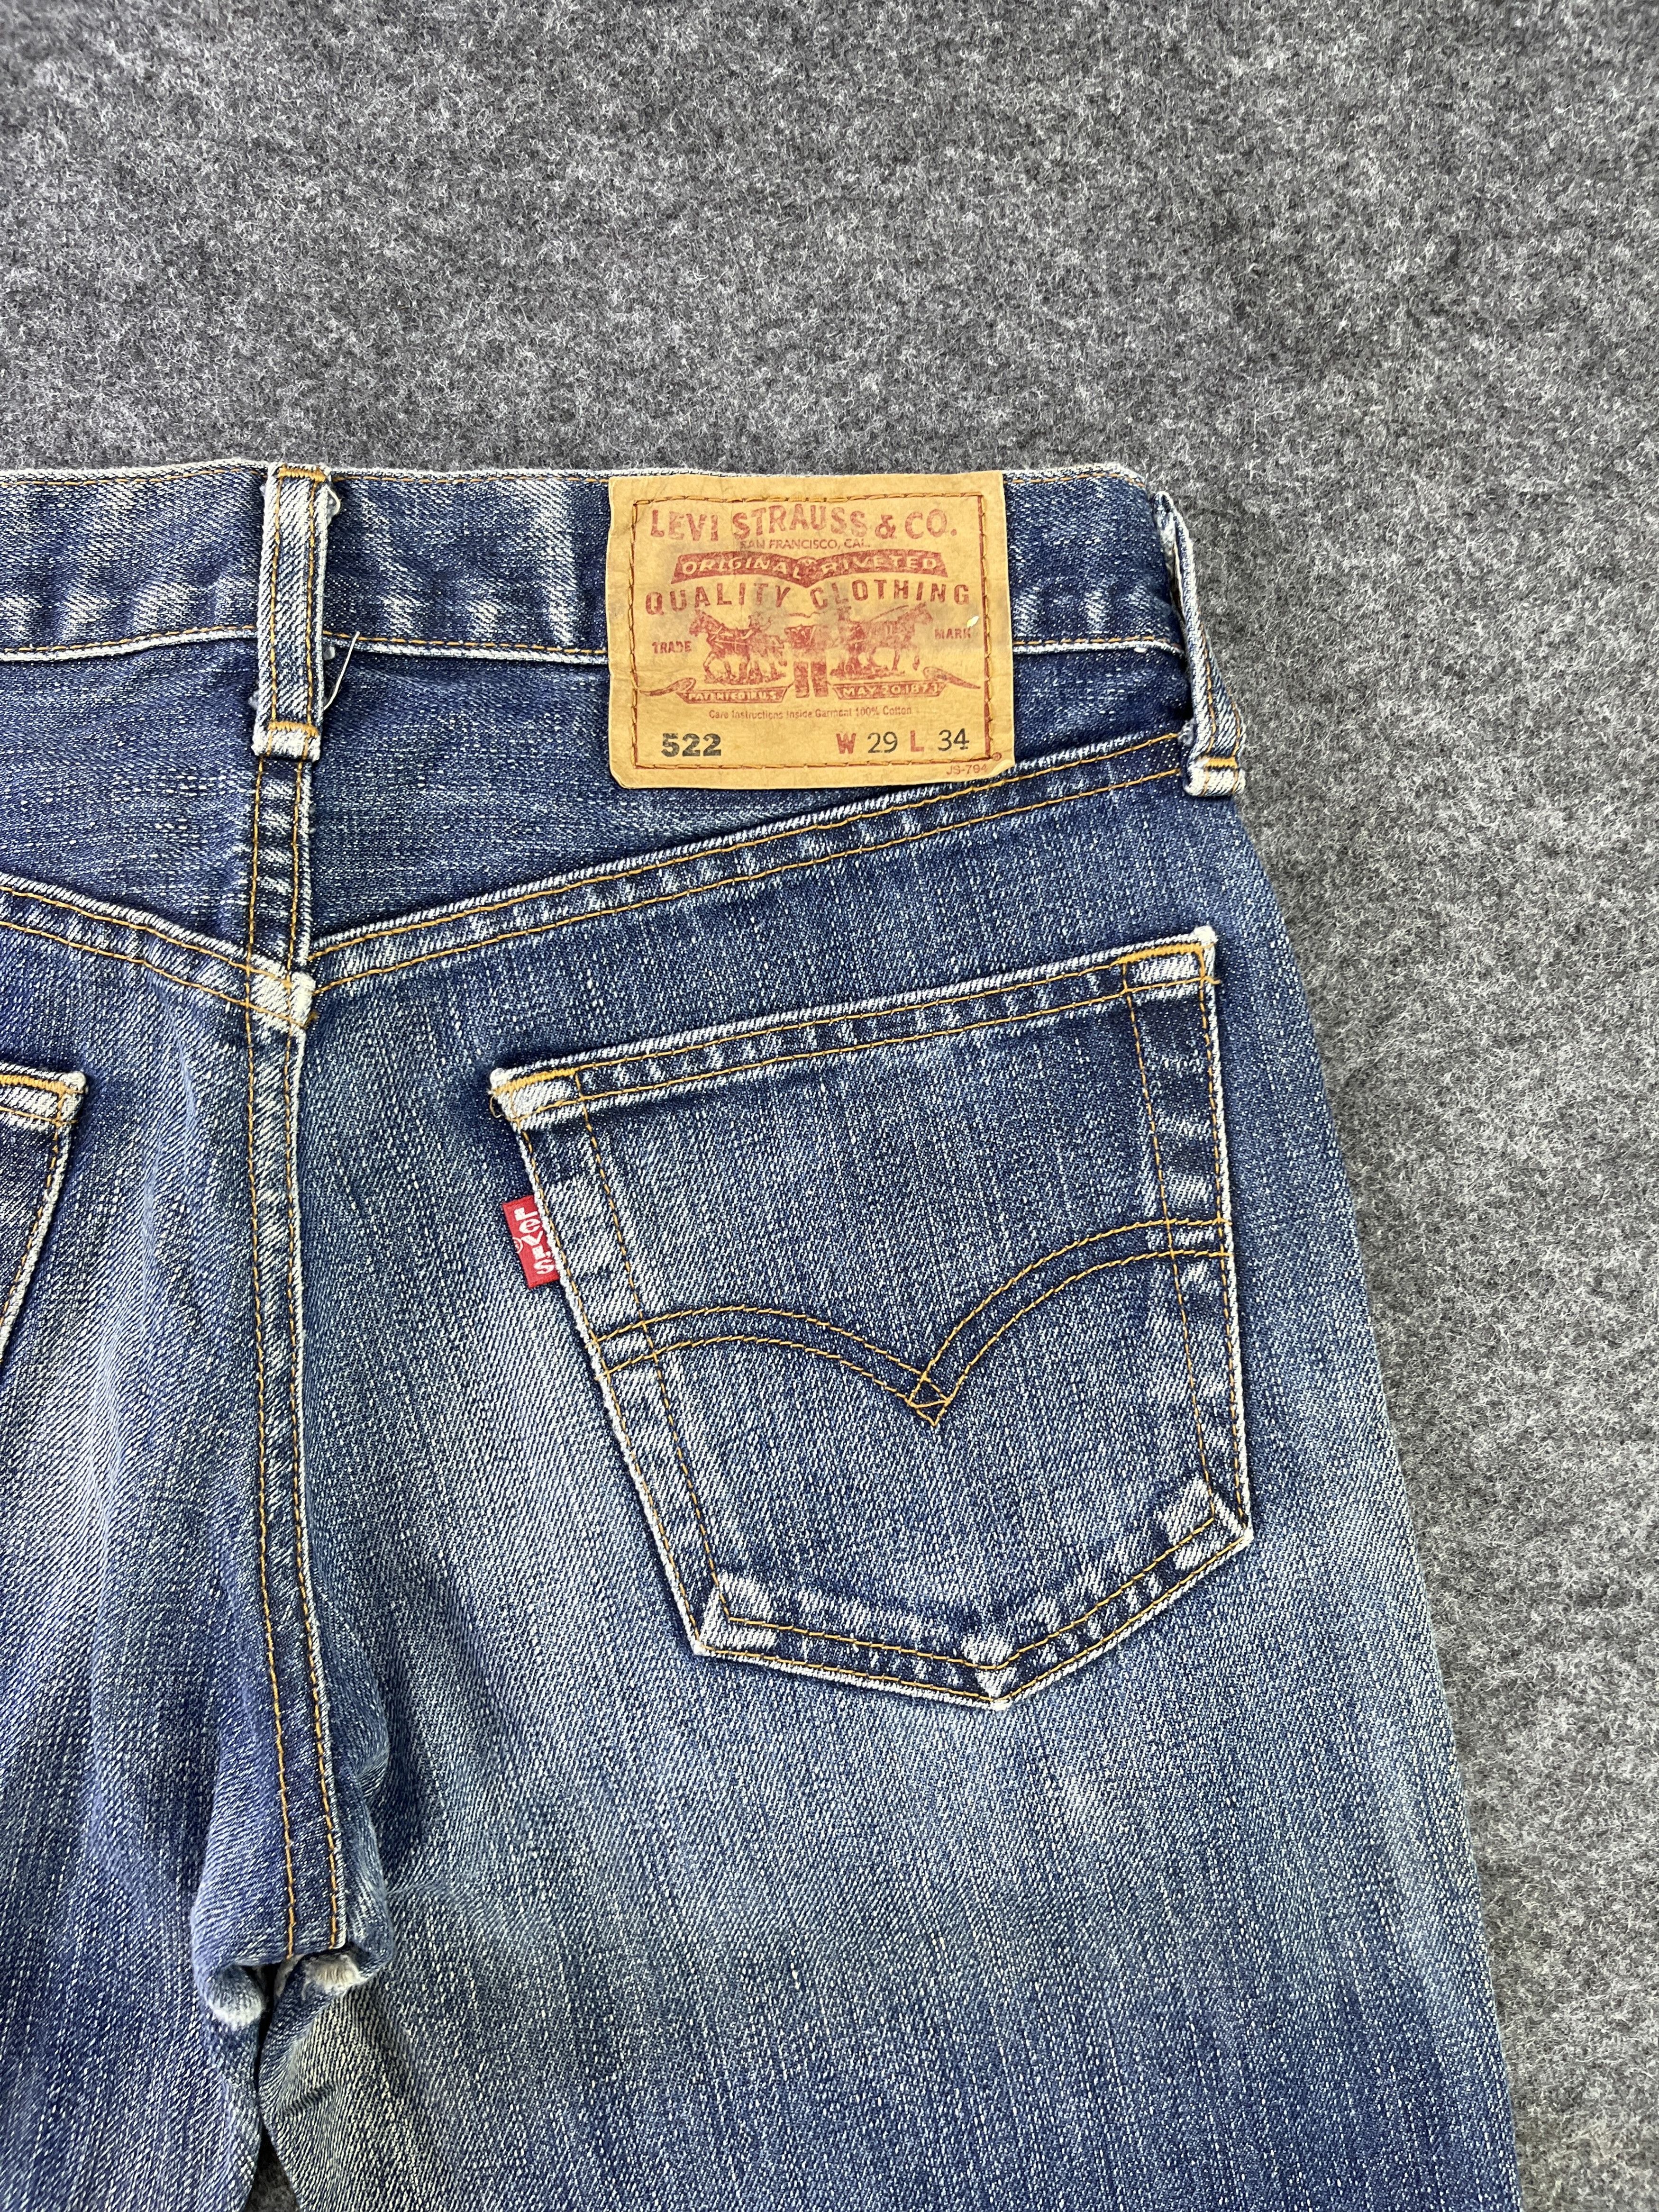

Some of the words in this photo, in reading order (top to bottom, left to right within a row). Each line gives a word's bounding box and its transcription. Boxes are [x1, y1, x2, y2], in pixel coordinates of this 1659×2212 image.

[651, 509, 719, 541] LEVI
[732, 503, 868, 541] STRAUSS
[875, 514, 896, 539] &
[904, 509, 957, 539] CO.
[740, 539, 765, 549] SAN
[769, 539, 841, 549] FRANCISCO,
[681, 557, 802, 579] ORIGINAL
[820, 555, 937, 575] RIVETED
[646, 582, 791, 615] QUALITY
[810, 579, 969, 610] CLOTHING
[934, 628, 971, 639] MARK
[652, 641, 692, 654] TRADE
[843, 685, 877, 696] MAY
[709, 710, 729, 719] Care
[732, 710, 783, 720] Instructions
[815, 708, 852, 718] Garment
[855, 706, 880, 717] 100%
[883, 706, 912, 716] Cotton
[661, 733, 721, 757] 522
[836, 733, 856, 754] W
[867, 731, 898, 753] 29
[910, 730, 924, 752] L
[938, 728, 969, 751] 34
